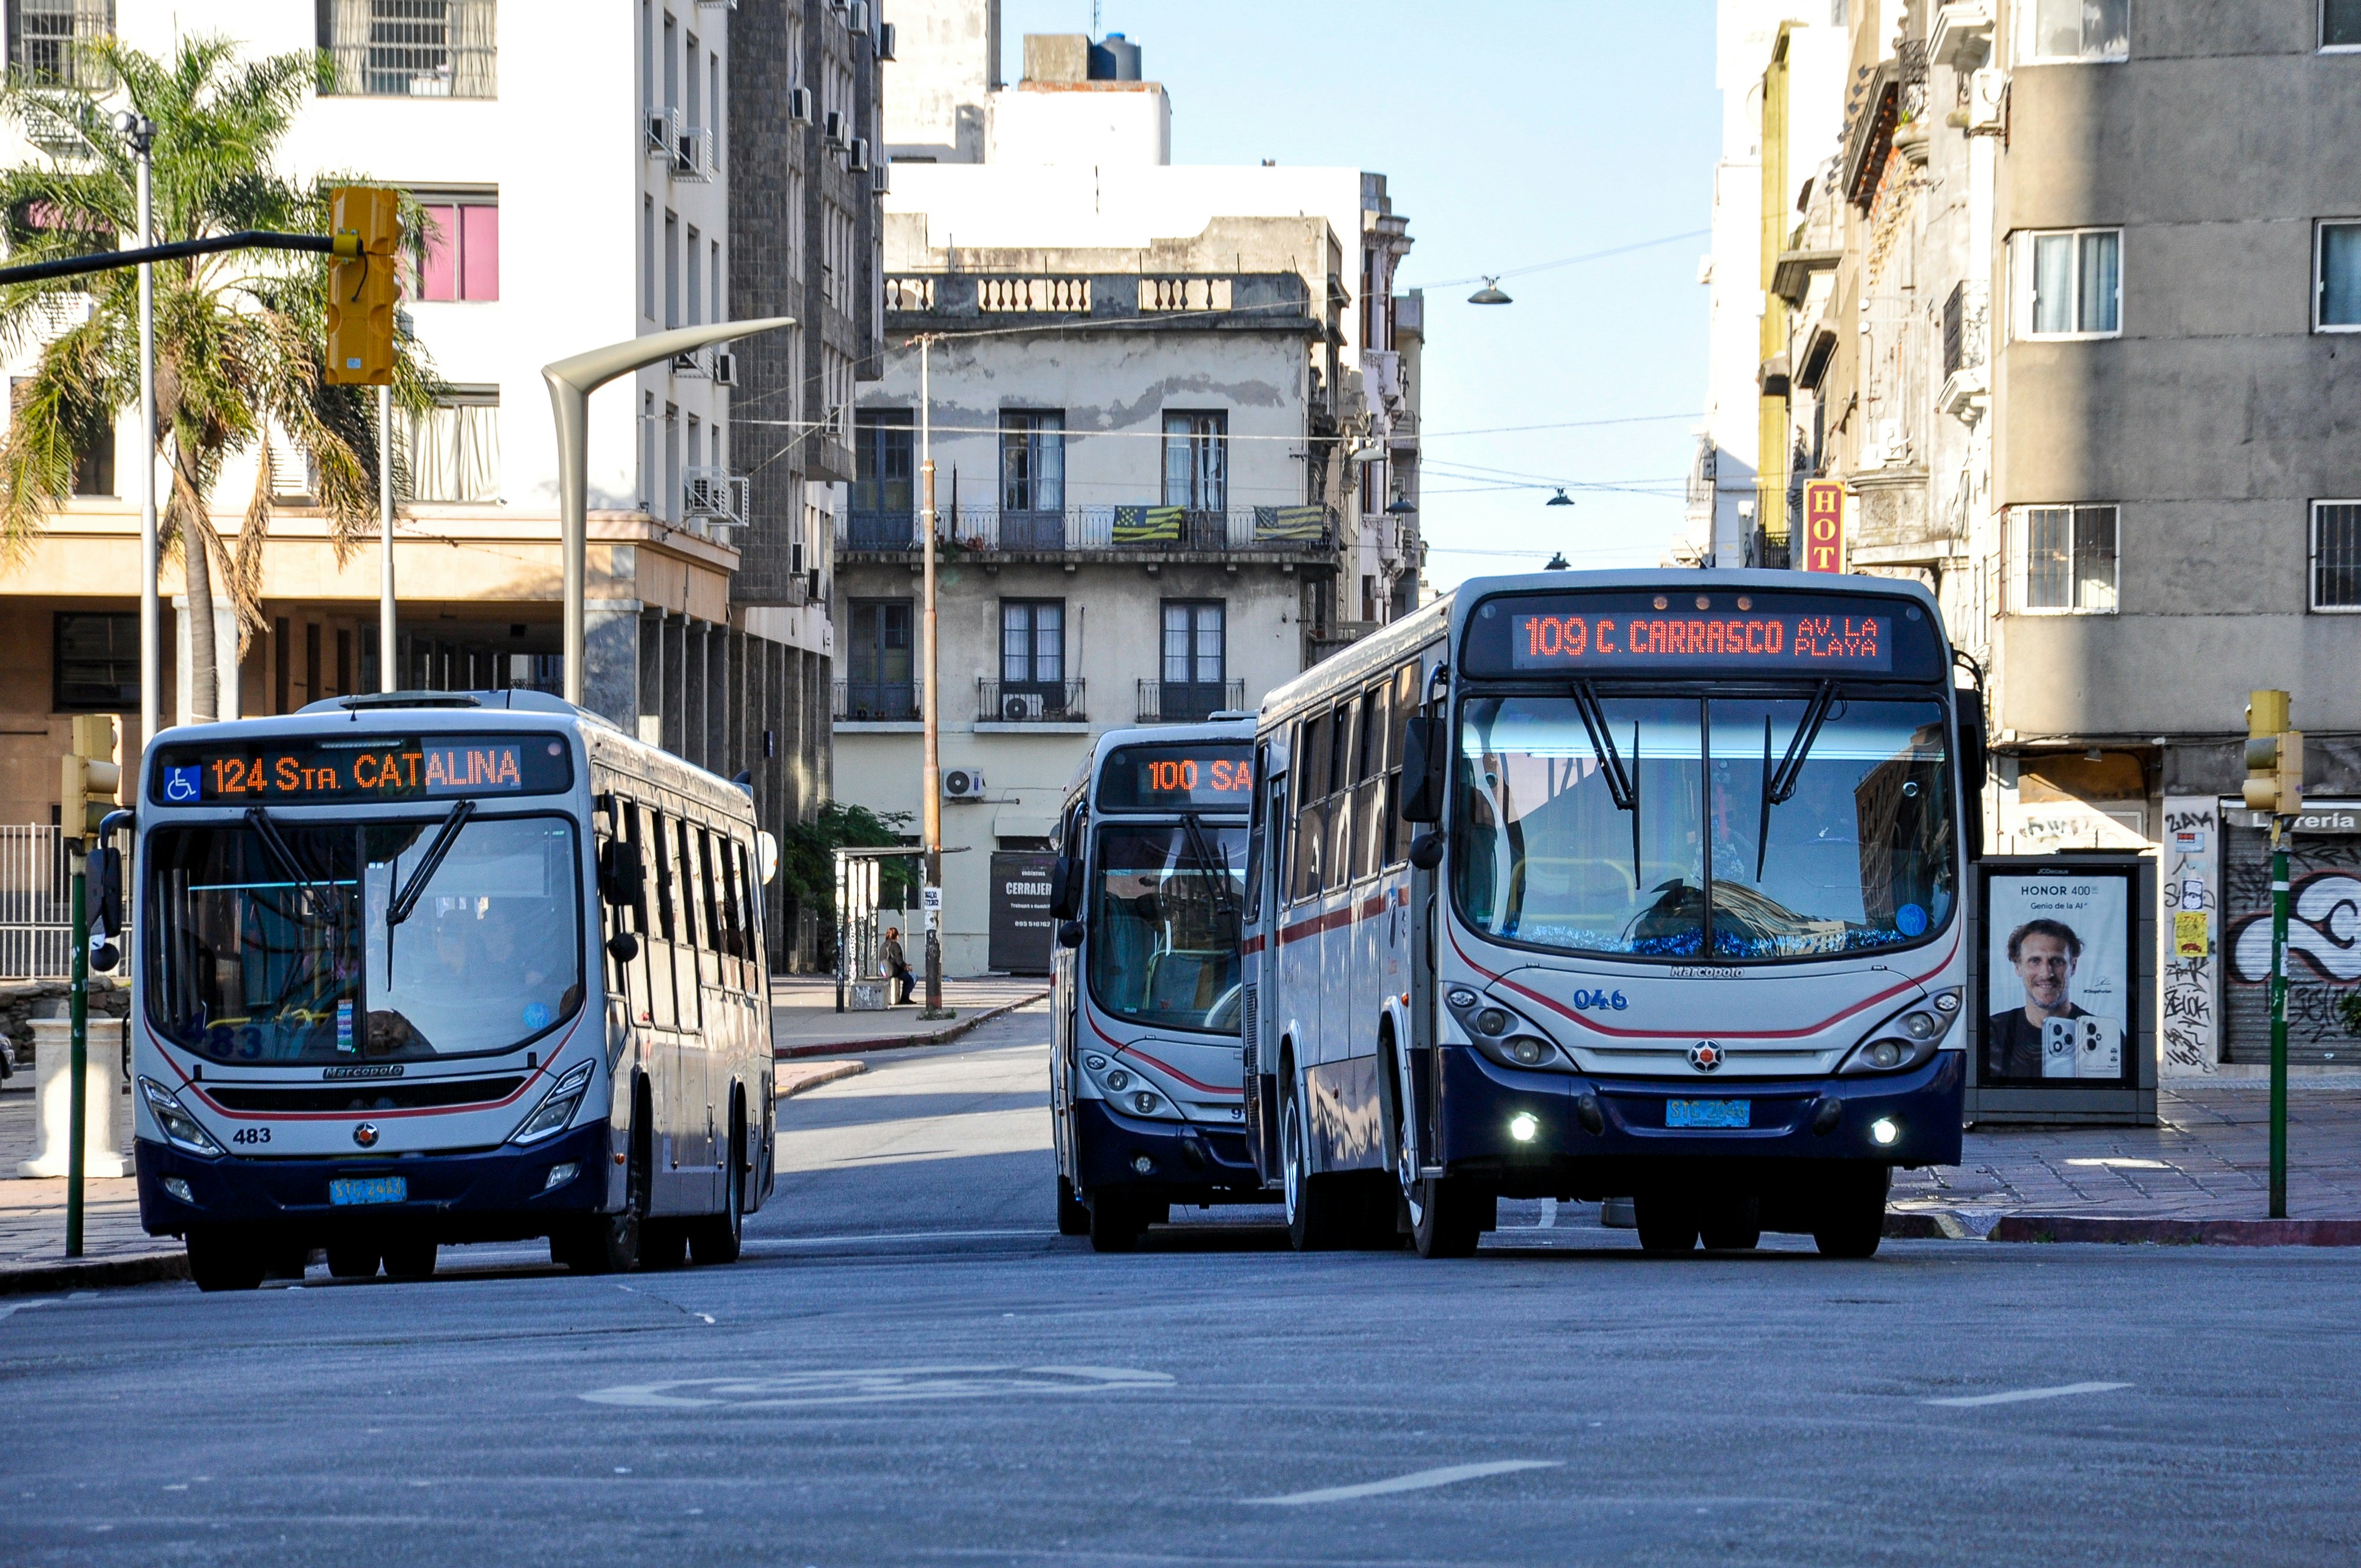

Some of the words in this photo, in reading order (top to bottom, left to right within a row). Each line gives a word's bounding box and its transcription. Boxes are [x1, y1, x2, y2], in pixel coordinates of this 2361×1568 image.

[1525, 617, 1587, 656] 109
[1596, 620, 1623, 654] C.
[1629, 620, 1783, 654] CARRASCO
[1797, 618, 1837, 637] AV.
[1845, 618, 1878, 637] LA
[1794, 638, 1877, 657] PLAYA
[212, 757, 267, 793] 124
[354, 749, 520, 788] CATALINA
[1149, 760, 1198, 790] 100
[2252, 812, 2355, 827] Lrería
[2021, 886, 2067, 895] HONOR
[2071, 886, 2091, 895] 400
[1670, 967, 1745, 978] Marcopolo
[1574, 989, 1628, 1010] 046
[326, 1065, 403, 1078] Marcopolo
[1670, 1101, 1700, 1118] STC
[233, 1128, 272, 1145] 483
